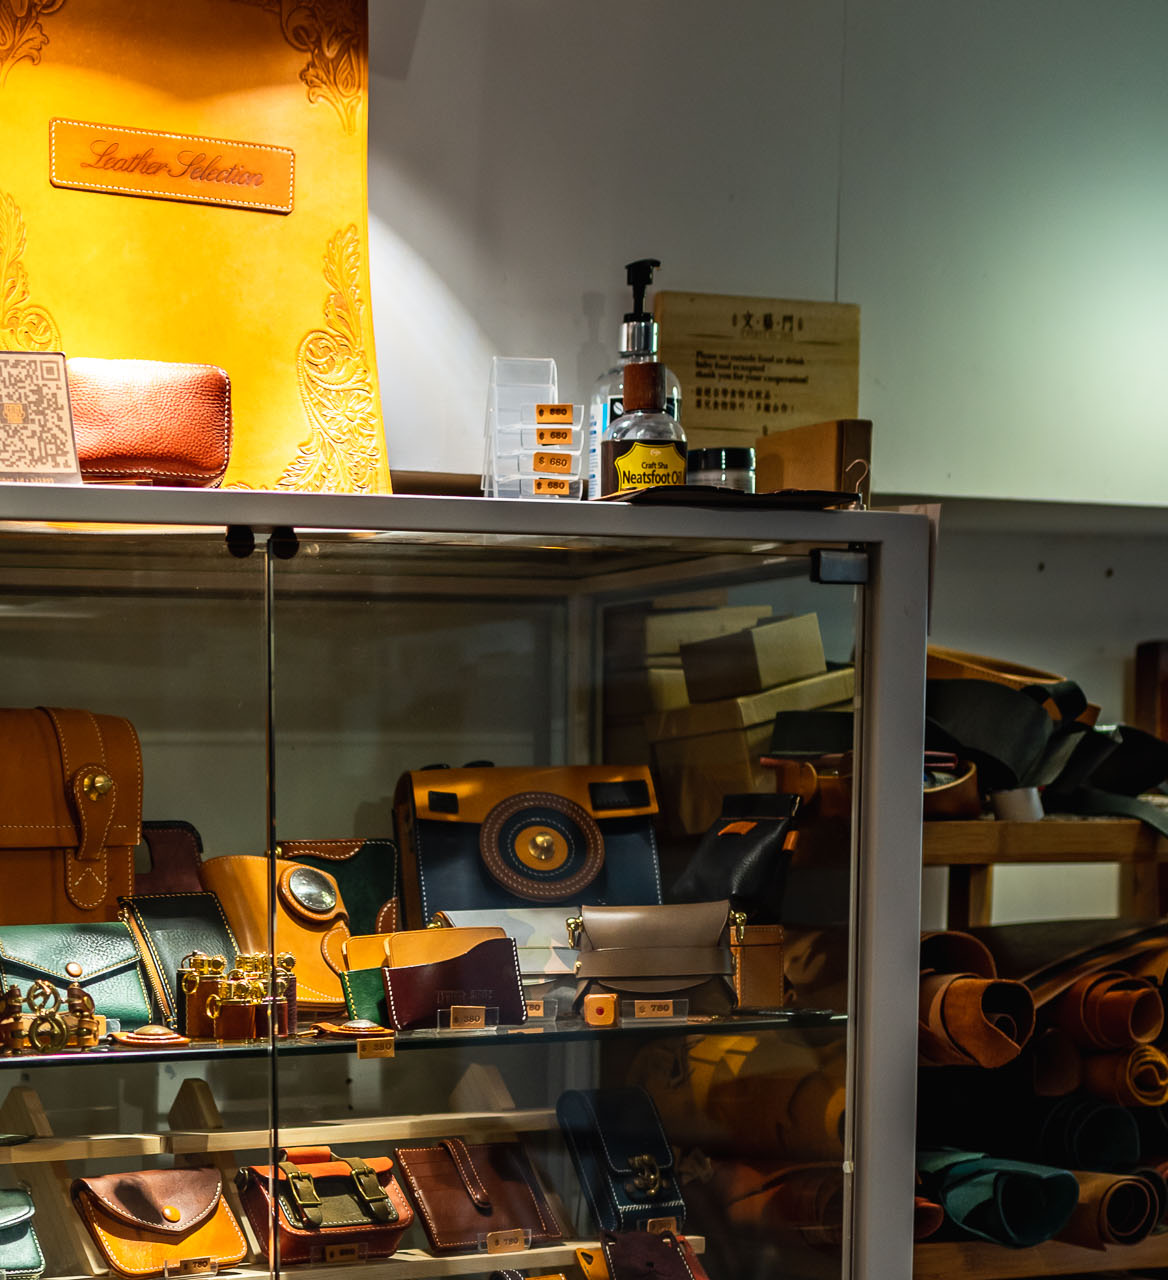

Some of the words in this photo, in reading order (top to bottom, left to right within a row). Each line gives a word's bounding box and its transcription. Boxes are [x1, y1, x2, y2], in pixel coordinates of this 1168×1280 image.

[80, 139, 169, 178] Leather
[164, 149, 266, 188] Selection
[550, 431, 568, 440] 680
[549, 457, 568, 467] 680
[641, 461, 657, 470] Craft
[657, 461, 669, 470] Sha
[622, 469, 671, 485] Neatsfoot
[547, 481, 565, 490] 680
[650, 1004, 671, 1012] 780
[192, 1260, 208, 1270] 780
